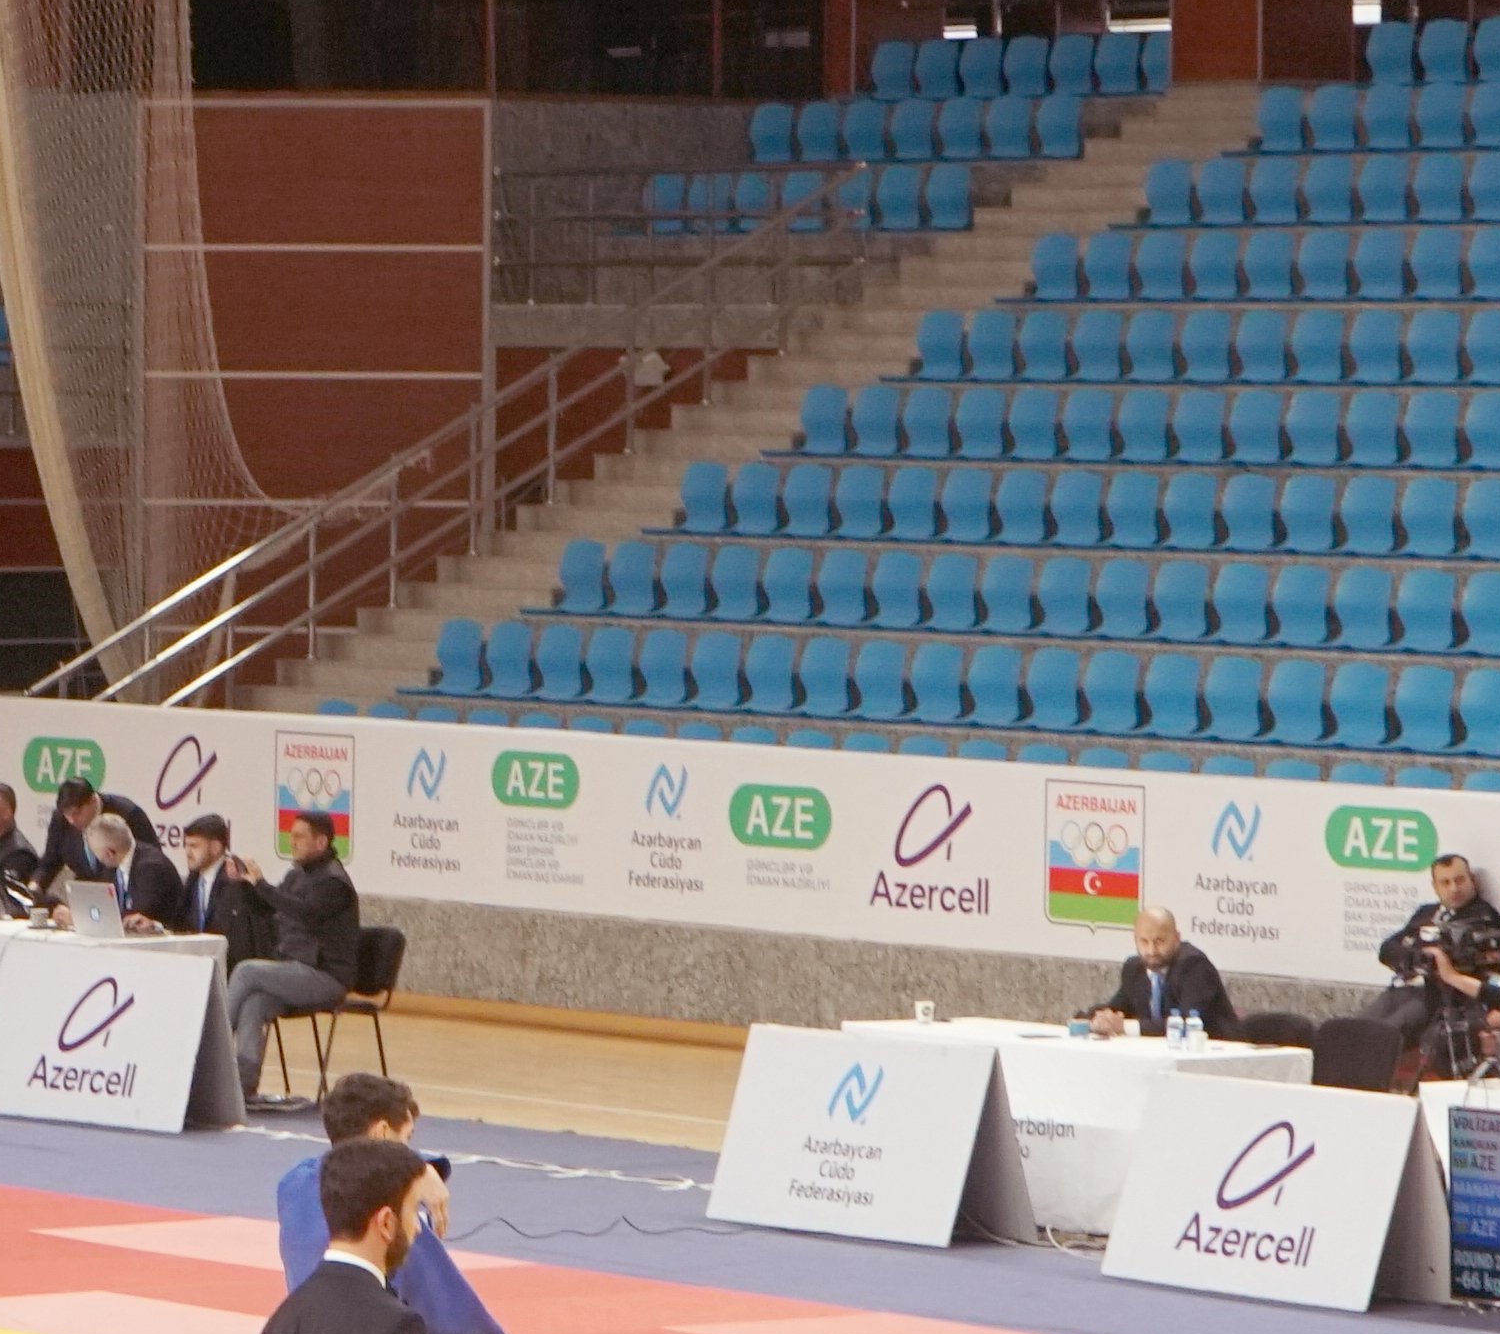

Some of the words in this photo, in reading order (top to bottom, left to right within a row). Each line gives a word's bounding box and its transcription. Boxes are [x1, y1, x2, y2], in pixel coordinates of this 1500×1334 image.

[284, 745, 348, 761] AZERBAIJAN
[506, 761, 564, 800] AZE
[745, 794, 814, 839] AZE
[1056, 794, 1137, 816] AZERBAIJAN
[1345, 818, 1419, 862] AZE
[870, 871, 989, 915] Azercell
[27, 1054, 137, 1099] Azercell
[1472, 1155, 1496, 1171] AZE
[1175, 1212, 1315, 1267] Azercell
